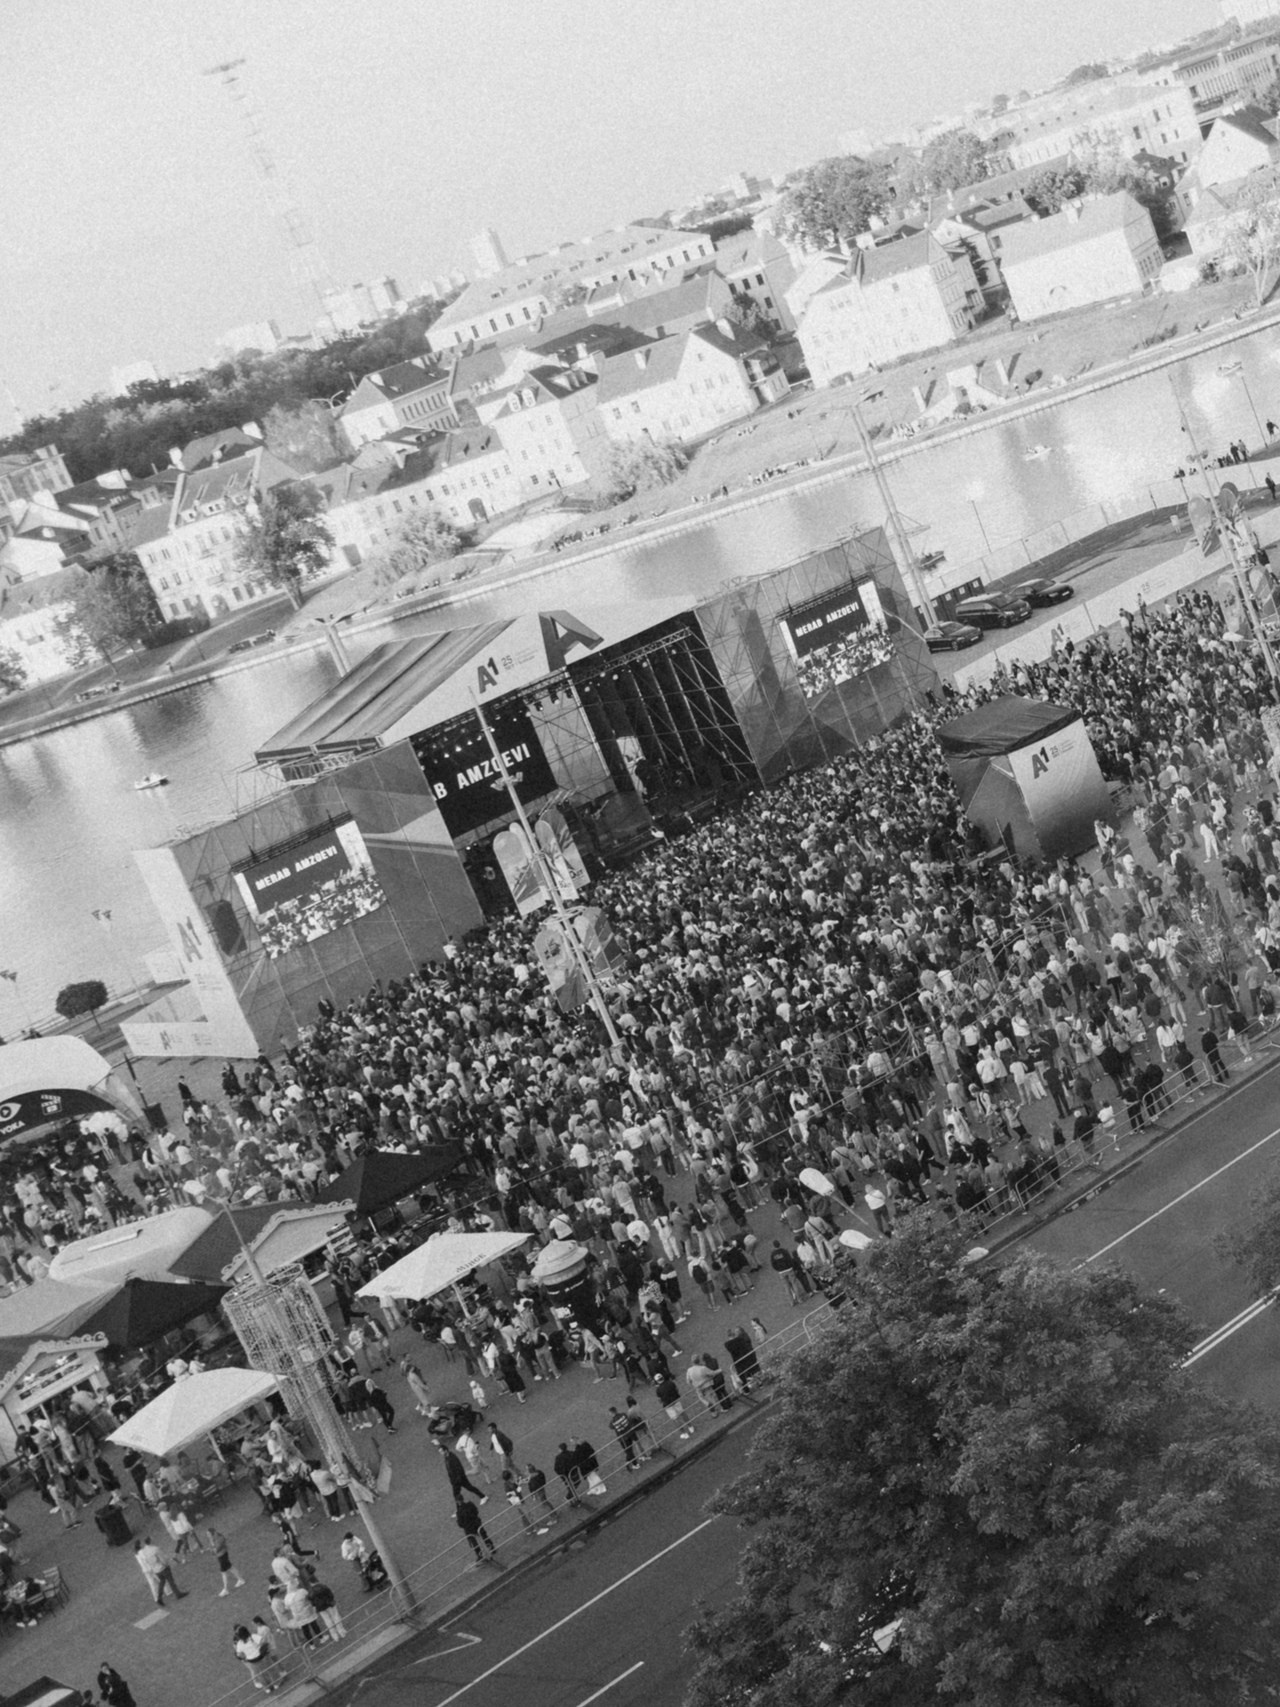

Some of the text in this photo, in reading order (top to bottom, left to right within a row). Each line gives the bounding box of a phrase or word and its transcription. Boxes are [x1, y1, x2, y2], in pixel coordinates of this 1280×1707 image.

[795, 601, 859, 637] MERAB AMZOEVI
[477, 657, 499, 694] A1
[1032, 746, 1049, 779] A1
[255, 845, 338, 890] MERAB AMZOEVI
